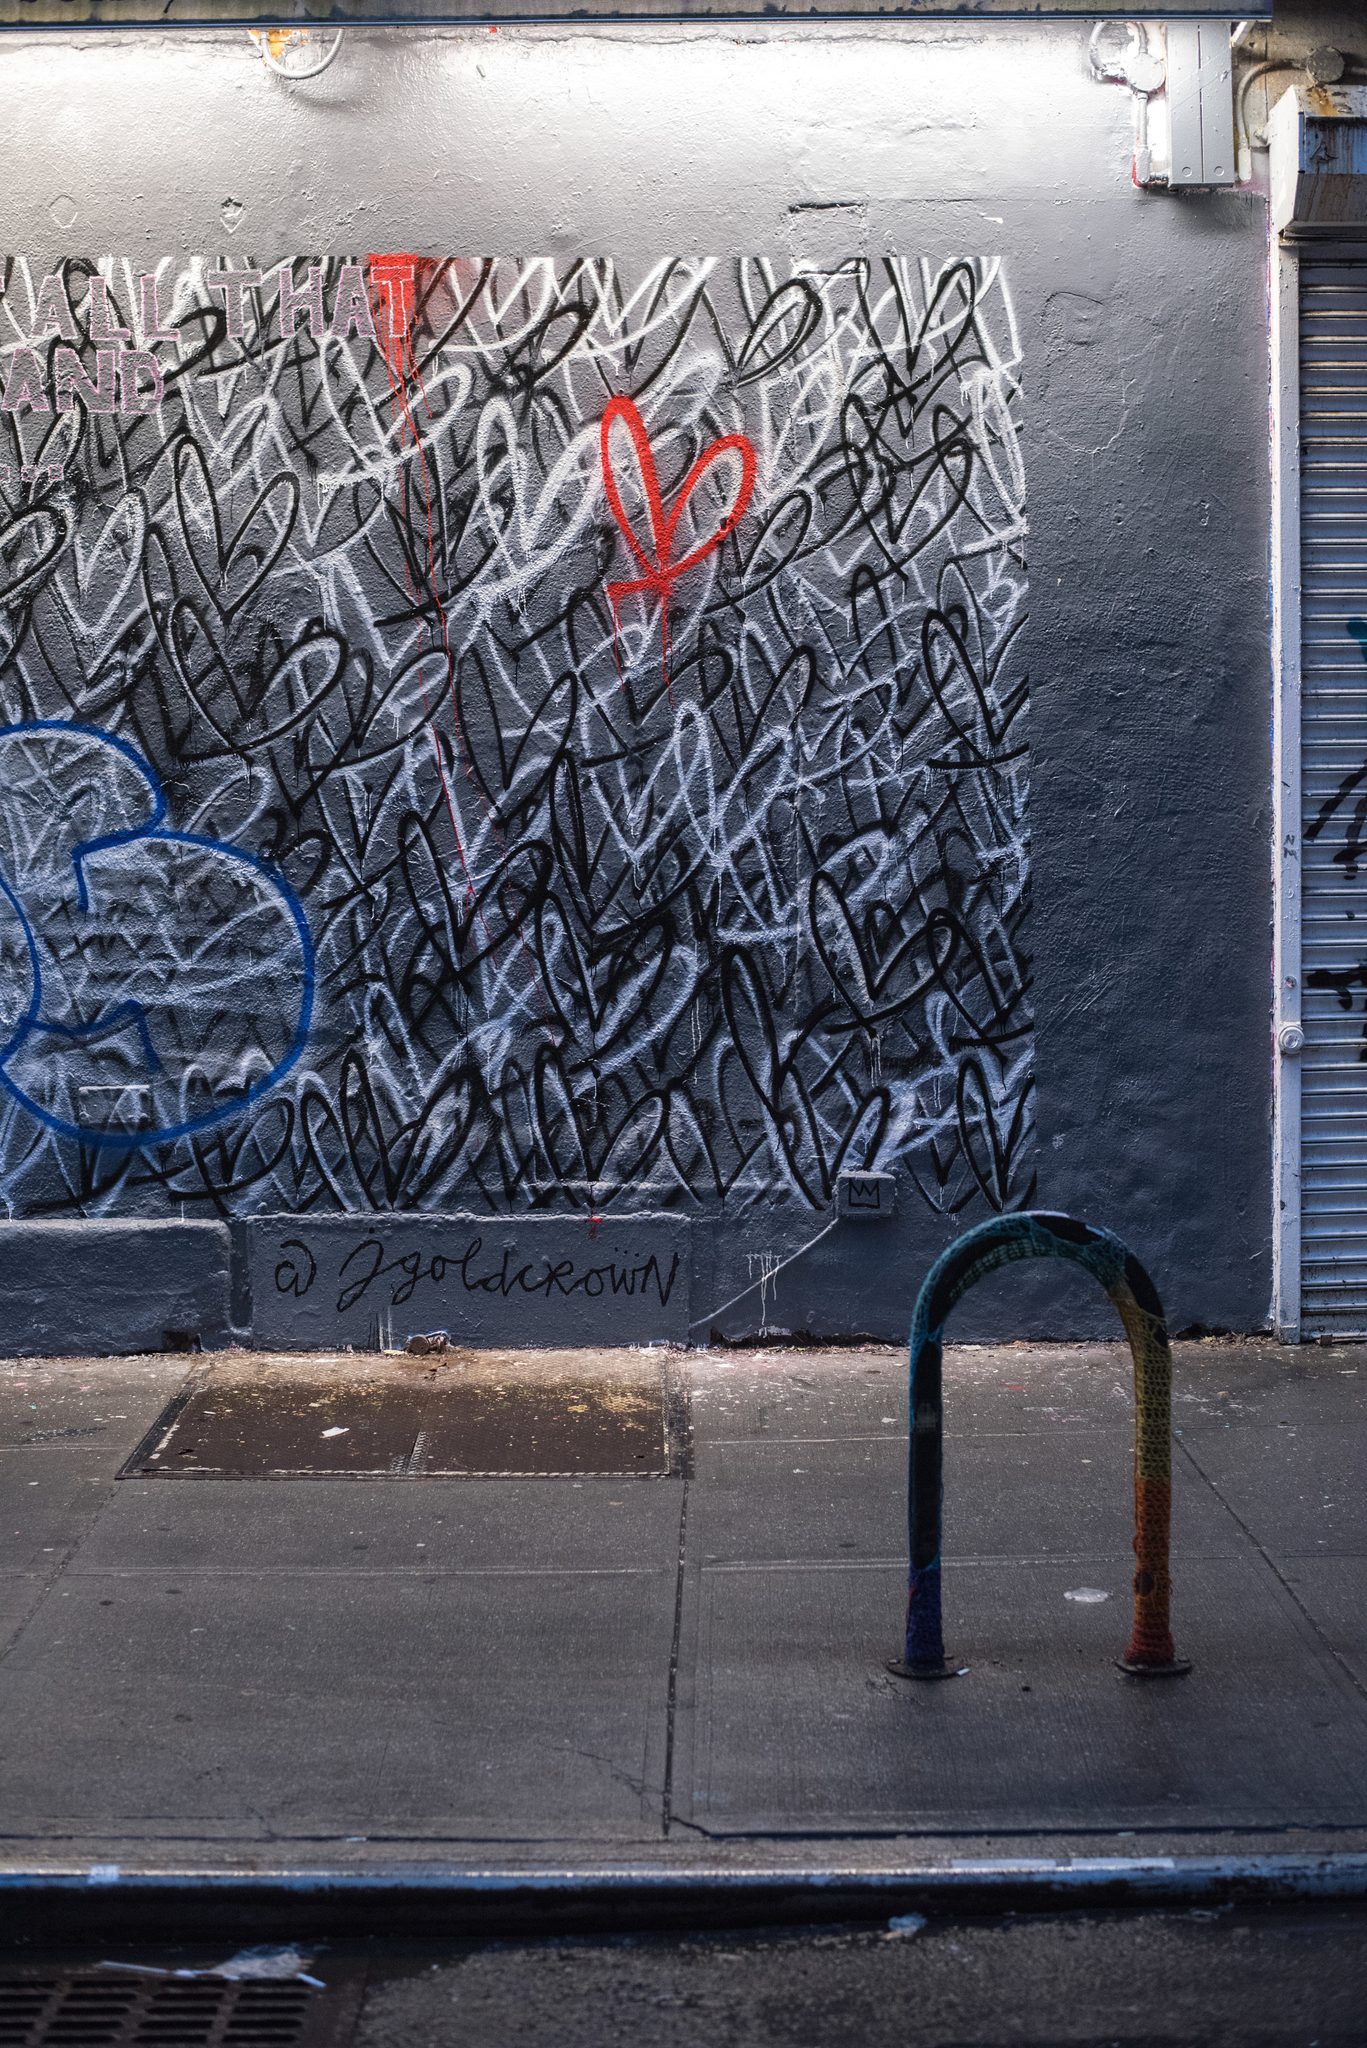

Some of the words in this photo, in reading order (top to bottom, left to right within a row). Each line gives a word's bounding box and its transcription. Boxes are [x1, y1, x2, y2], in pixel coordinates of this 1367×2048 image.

[29, 274, 181, 341] ALL
[207, 265, 415, 338] THAT
[0, 347, 165, 414] AND
